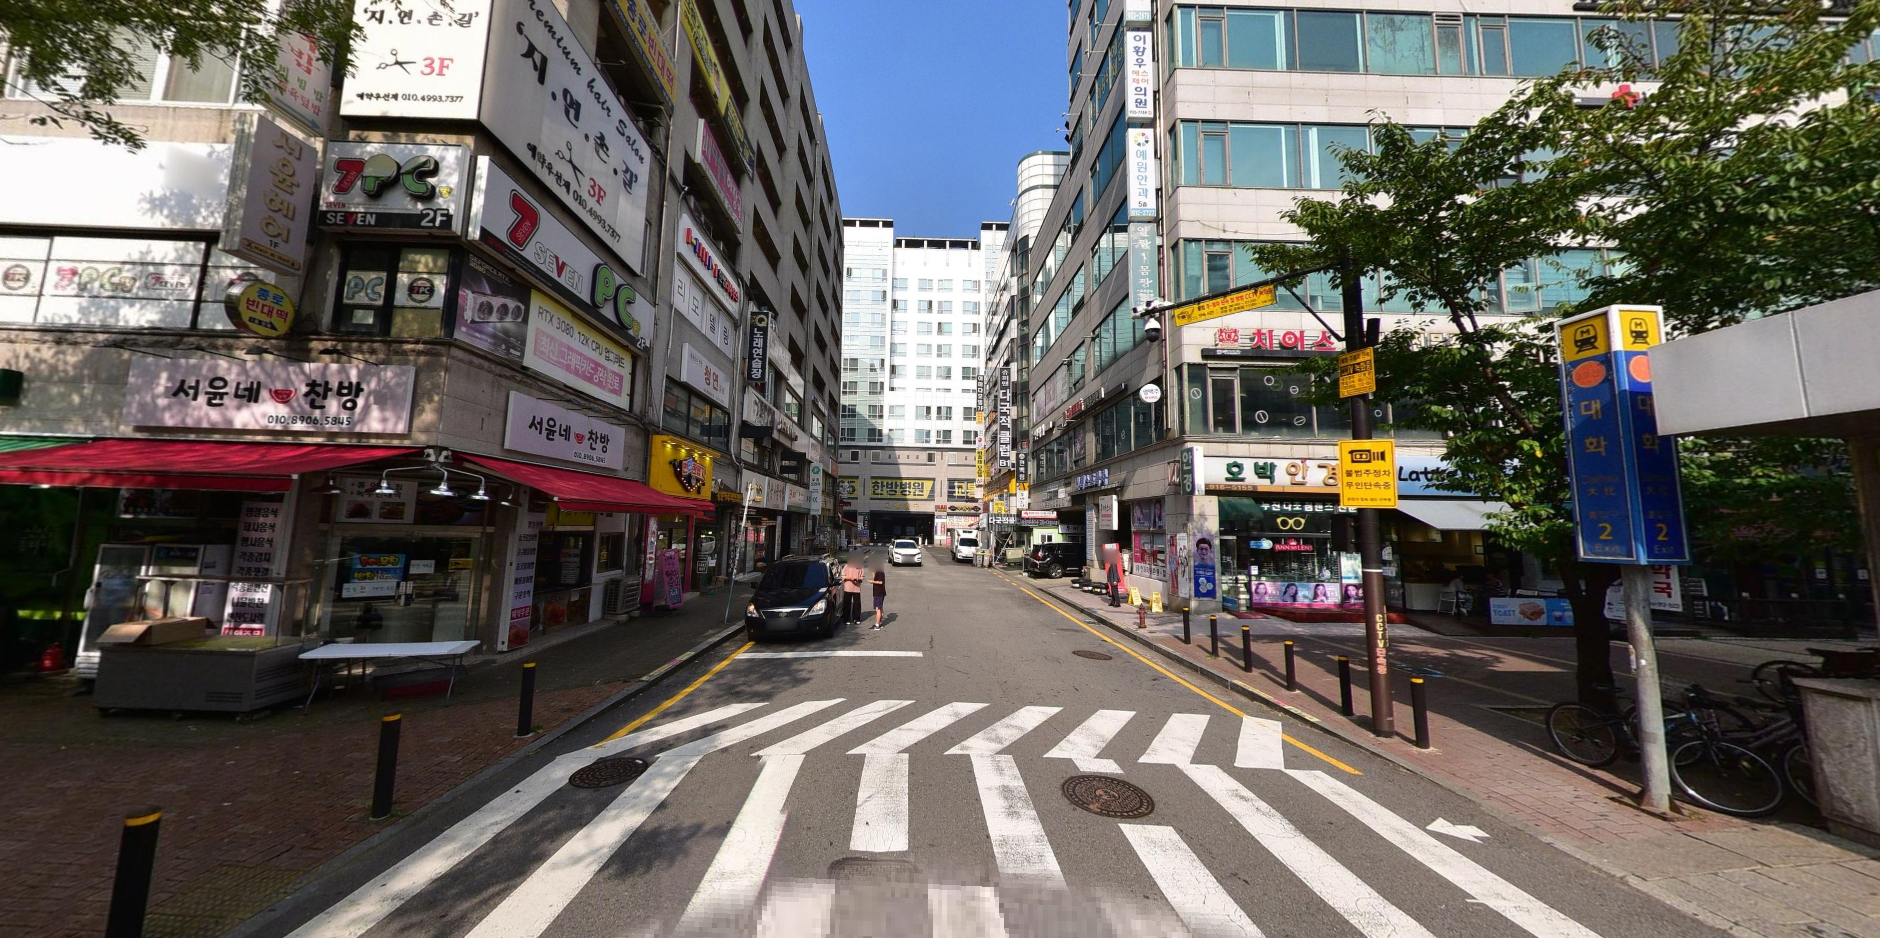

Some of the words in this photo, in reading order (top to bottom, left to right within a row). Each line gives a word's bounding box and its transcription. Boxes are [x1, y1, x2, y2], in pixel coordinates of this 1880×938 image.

[420, 57, 455, 77] 3F
[401, 93, 464, 104] 010.4993.7377
[1134, 86, 1148, 109] 의원
[586, 78, 612, 118] hair
[615, 118, 646, 165] Salon
[1136, 149, 1149, 199] 예원안과
[589, 176, 607, 206] 3F
[326, 212, 377, 226] SEVEN
[420, 208, 449, 227] 2F
[516, 219, 532, 242] SEVEN
[269, 239, 280, 248] 1F
[257, 286, 284, 306] 종로
[534, 241, 584, 294] SEVEN
[589, 262, 637, 331] PC
[246, 297, 290, 323] 빈대떡
[537, 305, 554, 325] RTX
[577, 331, 590, 348] 12K
[590, 340, 604, 356] CPU
[1251, 328, 1337, 351] 치어스
[751, 327, 764, 379] 노래연습장
[171, 376, 262, 407] 서윤네
[303, 379, 366, 412] 찬방
[1000, 388, 1011, 429] 다국적
[267, 414, 352, 427] 010.8906.5845
[1579, 399, 1608, 457] 대화
[528, 415, 572, 442] 서윤네
[587, 429, 610, 453] 찬방
[574, 451, 606, 464] 010.8906.5845
[1000, 459, 1011, 467] B1
[1182, 451, 1193, 493] 안경
[1345, 469, 1391, 477] 불법주정차
[871, 480, 925, 497] 한방병원
[1345, 481, 1392, 489] 무인단속중
[1597, 523, 1613, 540] 2
[1655, 523, 1669, 541] 2
